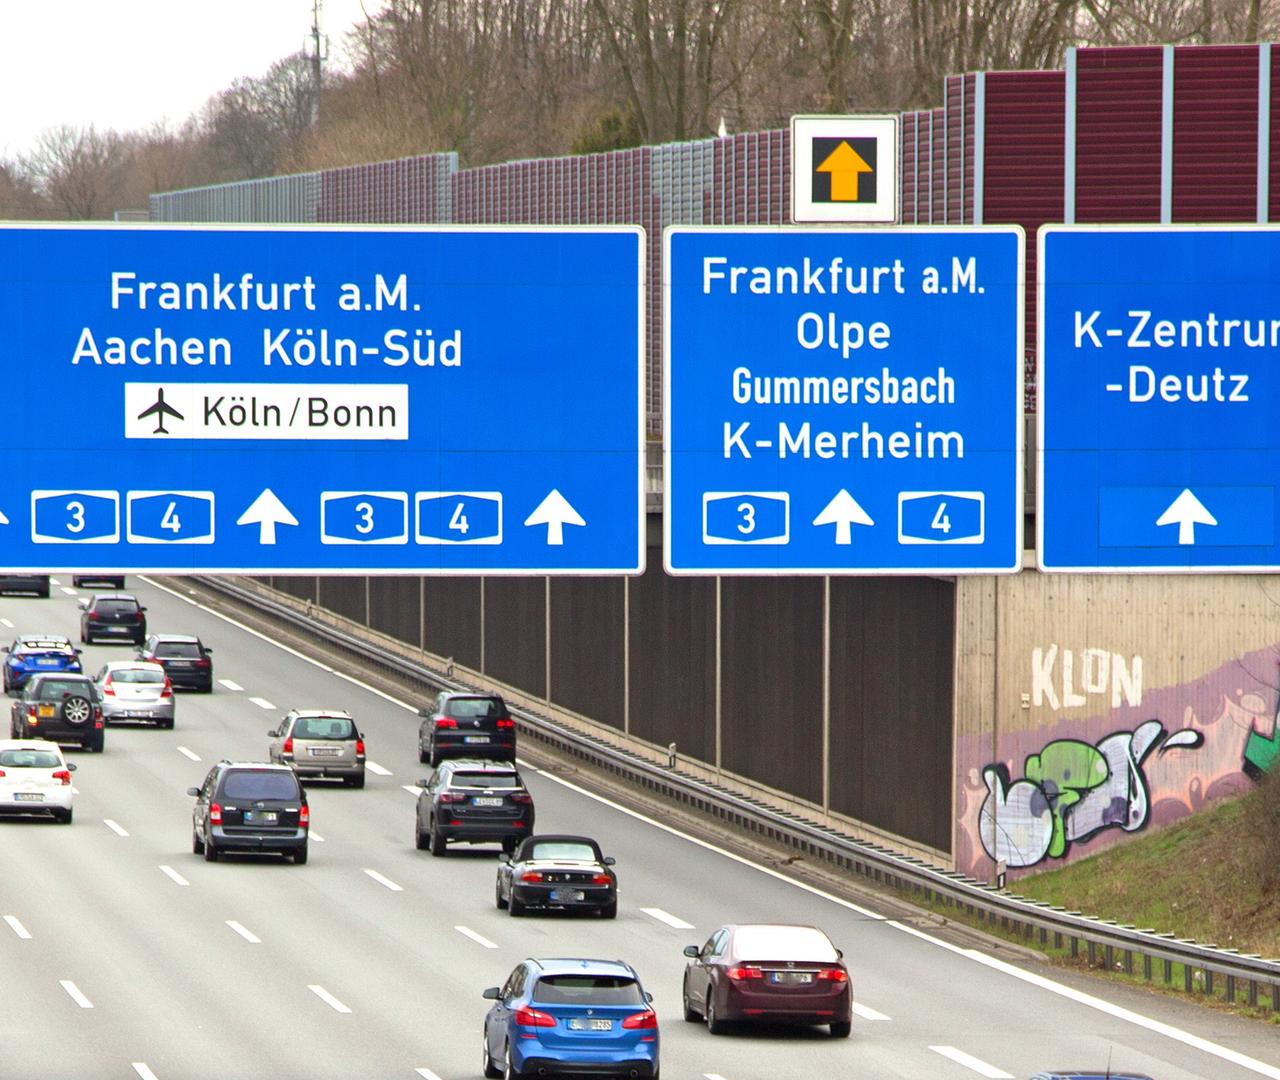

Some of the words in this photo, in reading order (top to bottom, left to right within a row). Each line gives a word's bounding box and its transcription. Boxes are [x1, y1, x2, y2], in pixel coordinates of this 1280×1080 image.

[111, 272, 316, 311] Frankfurt
[338, 274, 421, 311] a.M.
[703, 257, 905, 294] Frankfurt
[922, 258, 985, 294] a.M.
[72, 327, 231, 366] Aachen
[263, 328, 461, 367] Köln-Süd
[797, 312, 890, 359] Olpe
[732, 367, 956, 404] Gummersbach
[1106, 365, 1250, 402] -Deutz
[204, 396, 397, 427] Köln/Bonn
[724, 422, 964, 459] K-Merheim
[65, 502, 86, 533] 3
[160, 502, 181, 533] 4
[355, 502, 374, 534] 3
[449, 503, 469, 534] 4
[737, 503, 756, 534] 3
[931, 503, 951, 533] 4
[1030, 644, 1144, 711] KLON
